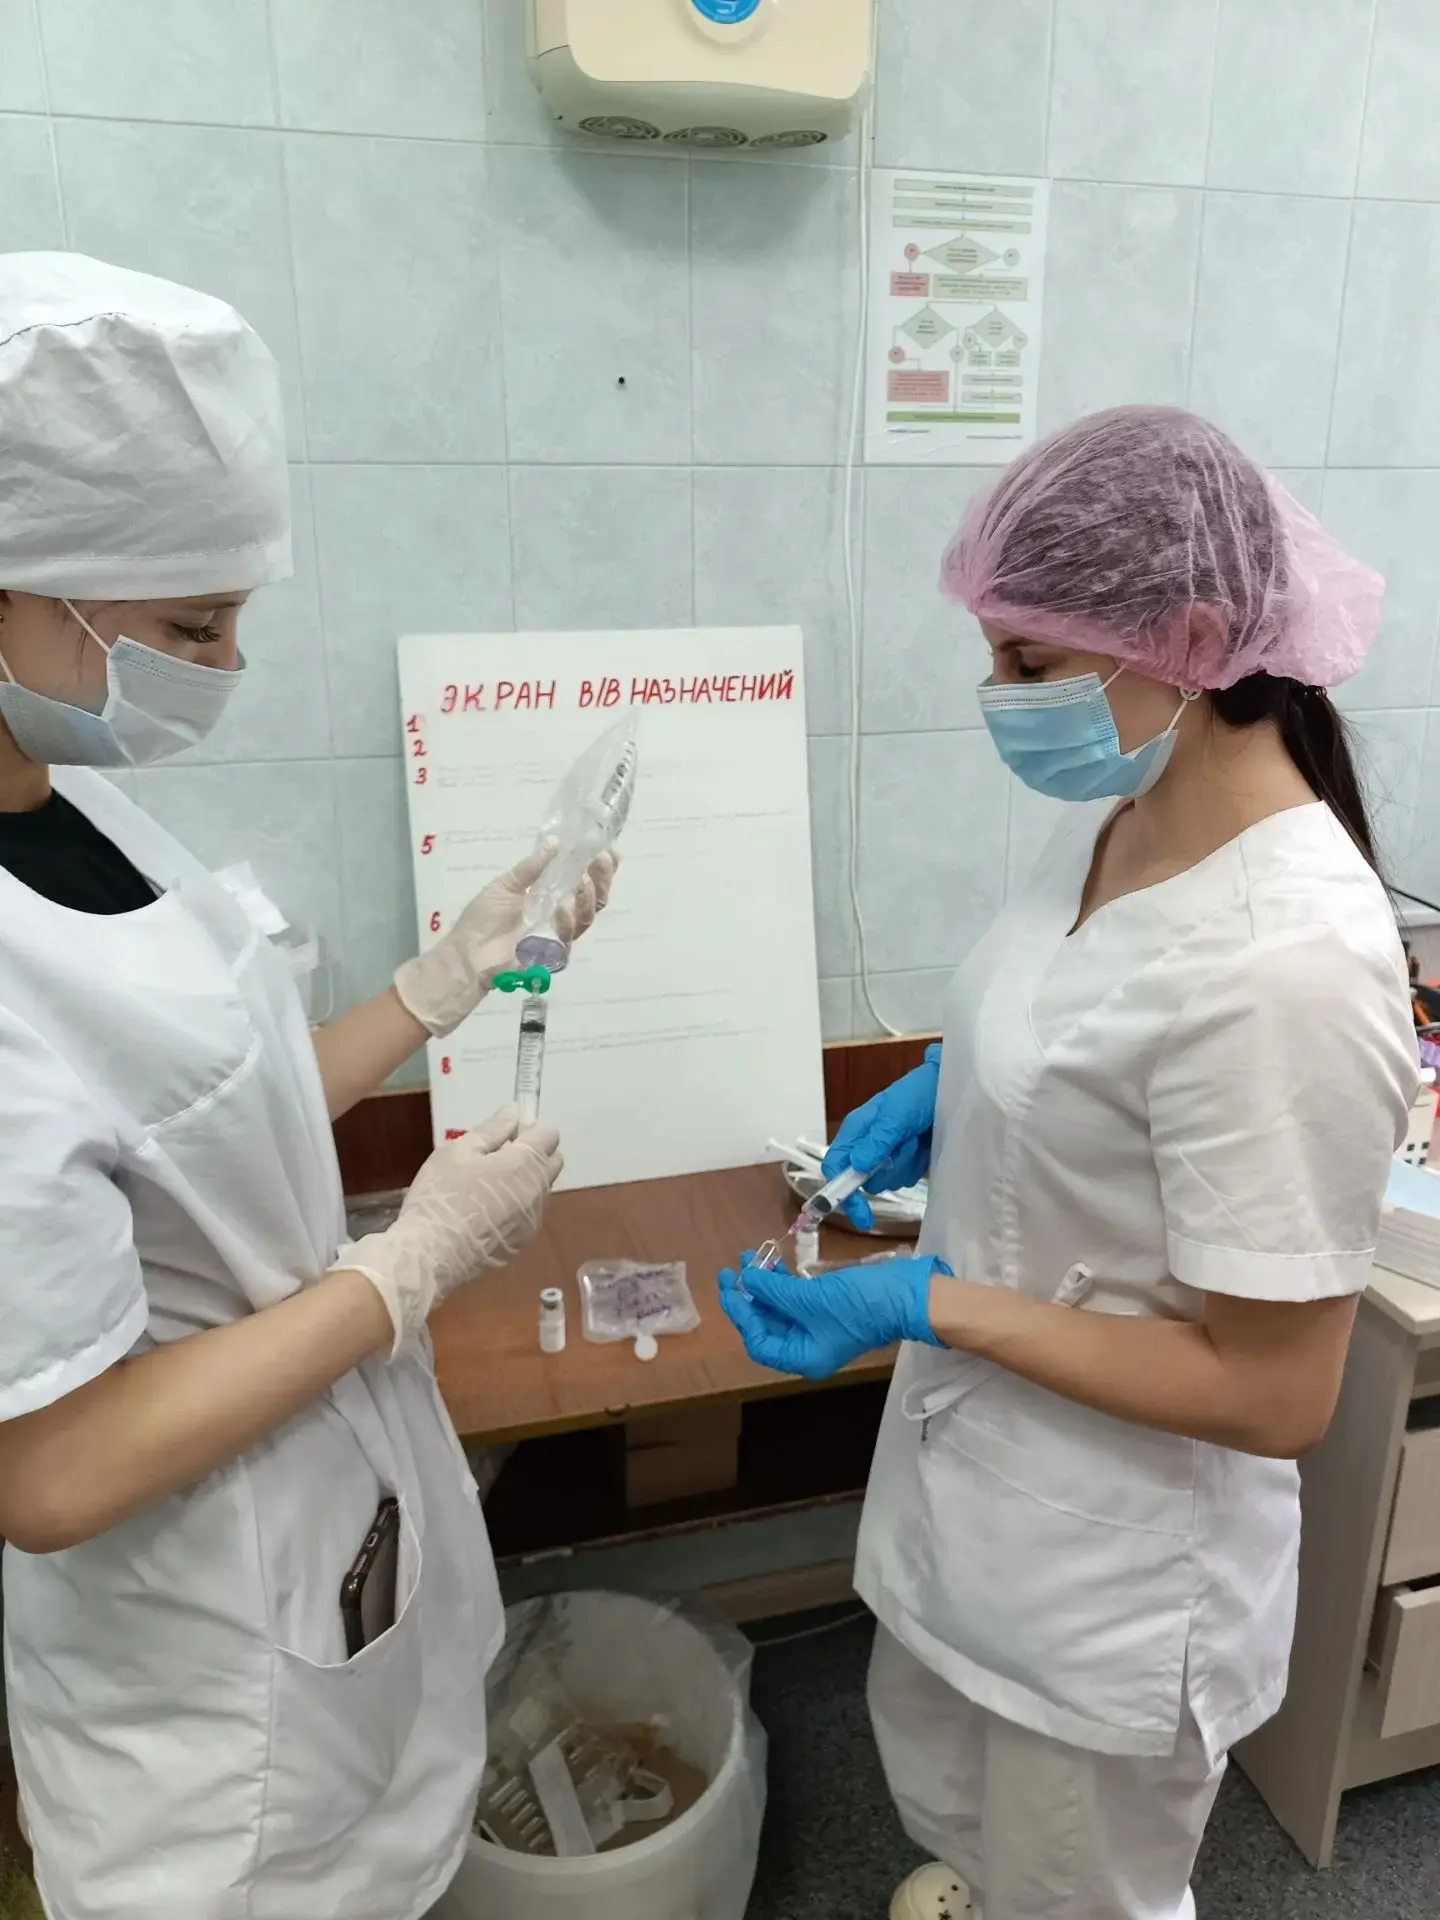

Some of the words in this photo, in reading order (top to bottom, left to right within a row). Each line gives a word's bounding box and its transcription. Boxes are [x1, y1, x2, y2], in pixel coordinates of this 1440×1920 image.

[441, 679, 557, 714] ЭКРАН
[578, 677, 622, 708] В/В
[631, 669, 794, 704] НАЗНАЧЕНИЙ
[407, 715, 420, 733] 1
[413, 740, 428, 757] 2
[414, 767, 427, 785] 3
[421, 834, 436, 855] 5
[430, 911, 441, 933] 6
